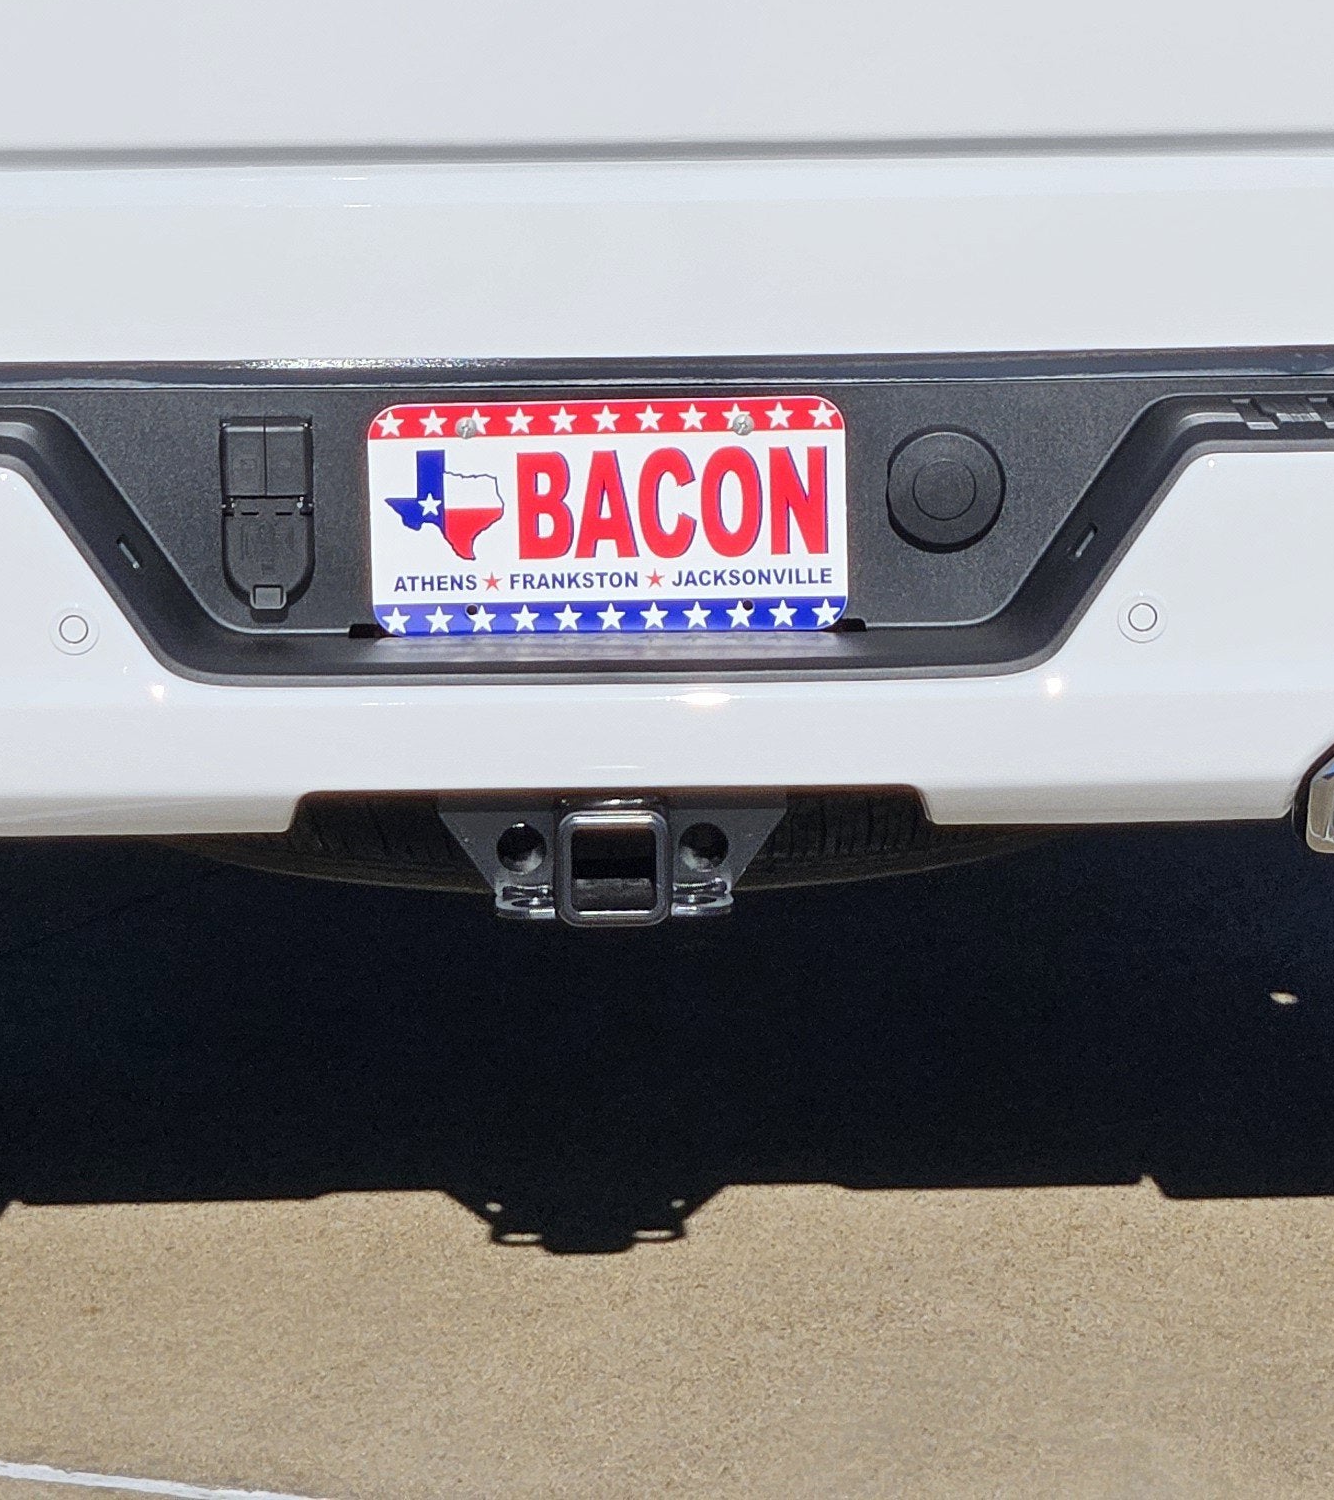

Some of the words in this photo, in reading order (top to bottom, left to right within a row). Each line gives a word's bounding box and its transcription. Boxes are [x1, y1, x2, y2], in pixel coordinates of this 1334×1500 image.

[516, 445, 829, 560] BACON
[393, 572, 478, 593] ATHENS
[509, 569, 639, 590] FRANKSTON
[671, 567, 833, 588] JACKSONVILLE
